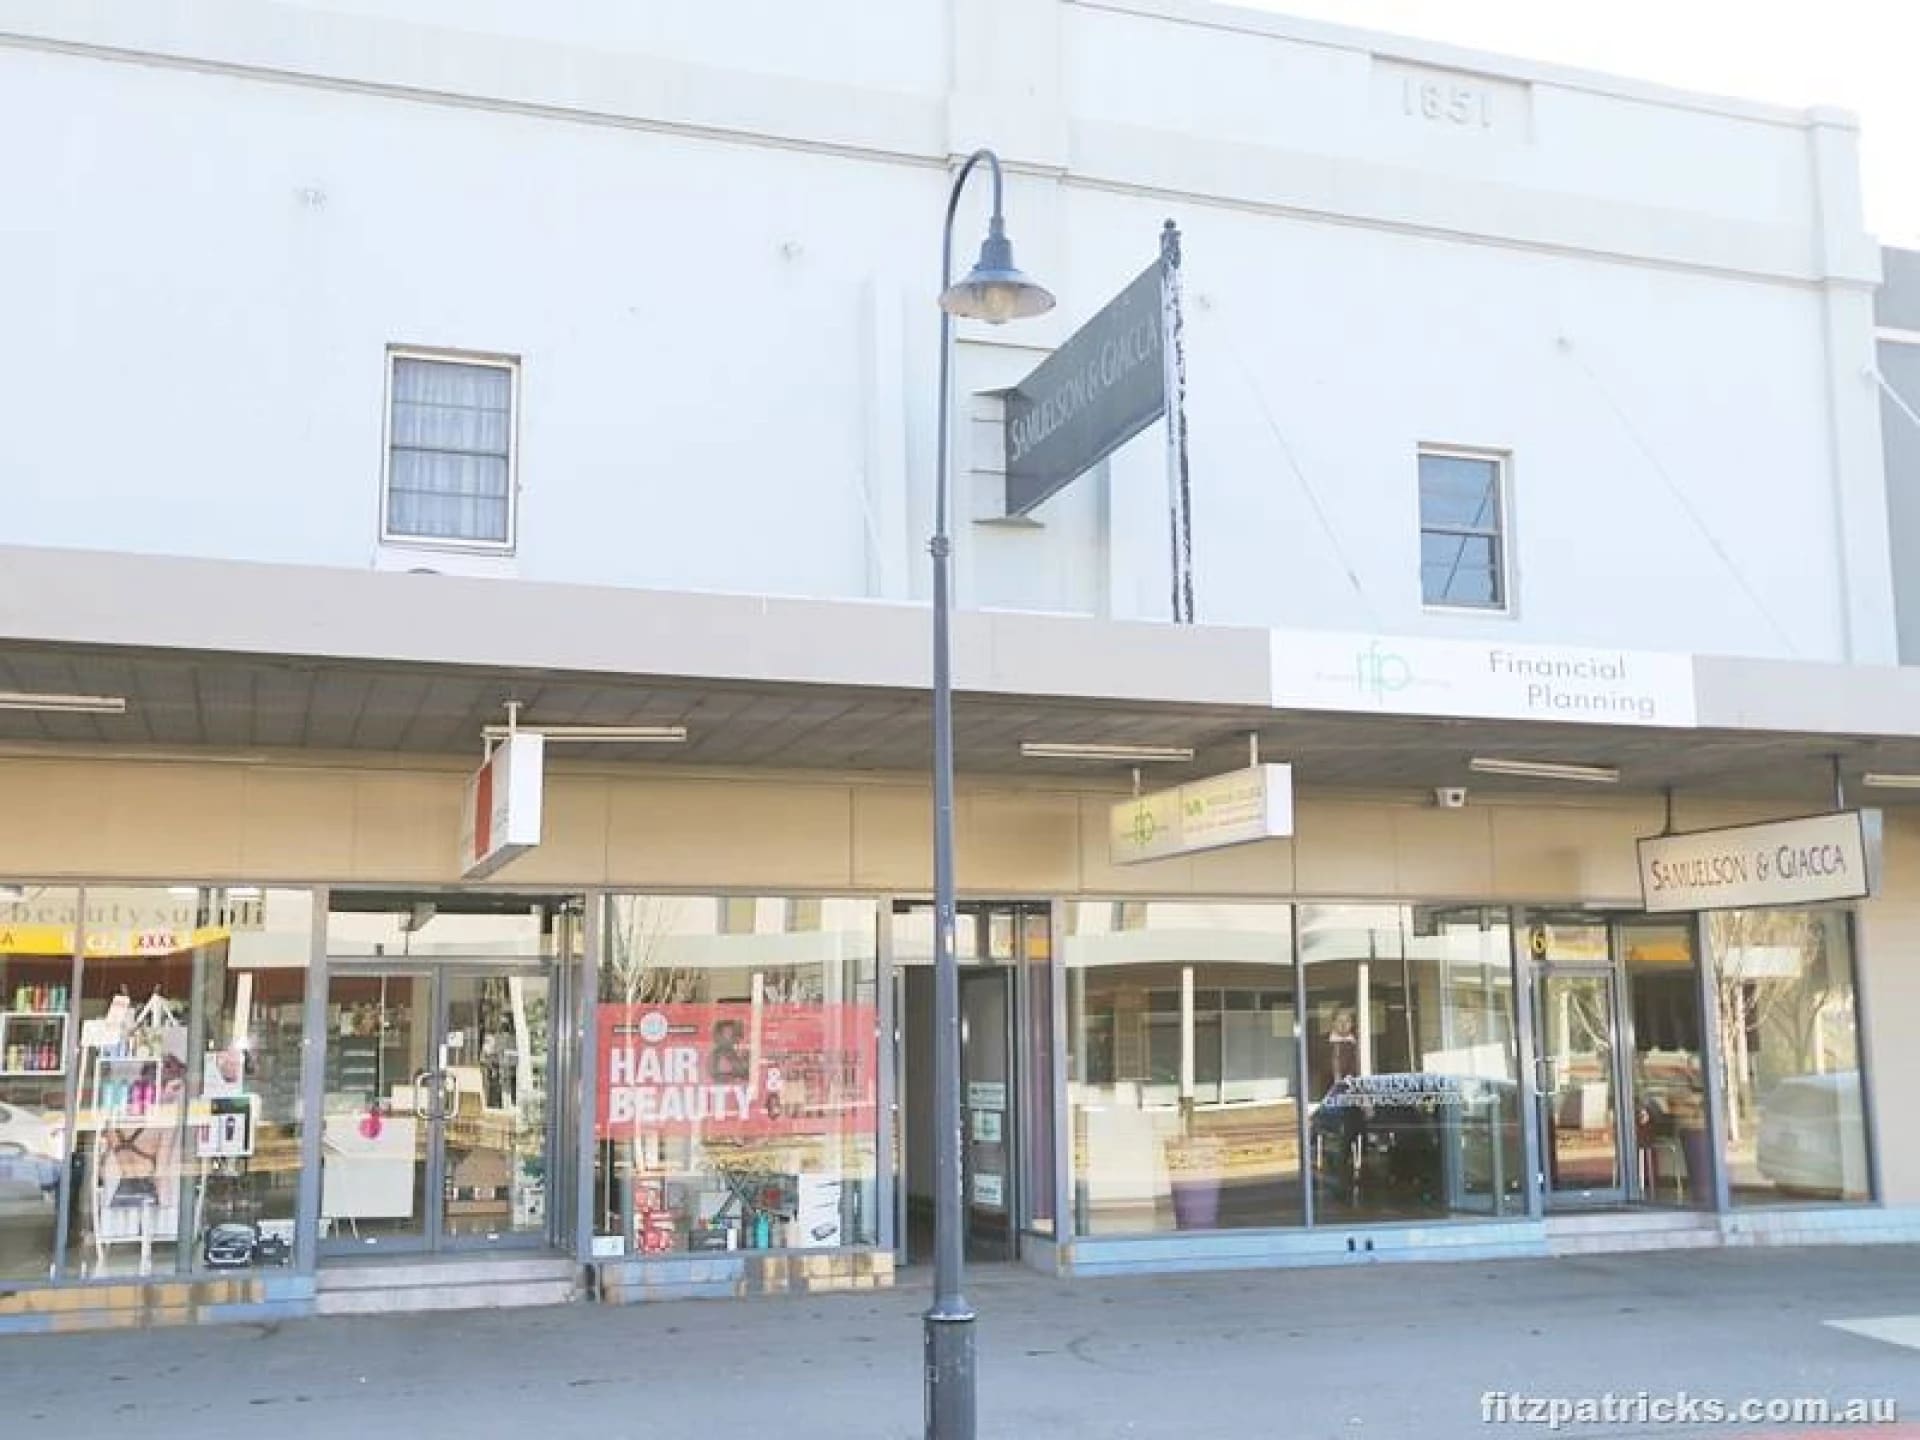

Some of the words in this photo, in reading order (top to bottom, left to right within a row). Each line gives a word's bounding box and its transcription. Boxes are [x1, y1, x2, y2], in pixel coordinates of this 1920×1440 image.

[1010, 364, 1088, 462] SAMUELSON
[1101, 312, 1158, 387] GIACCA
[1489, 649, 1626, 681] Financial
[1527, 683, 1656, 718] Planning
[1651, 852, 1748, 891] SAMUELSON
[1757, 851, 1768, 881] &
[1776, 844, 1847, 879] GIACCA
[610, 1047, 699, 1085] HAIR
[608, 1083, 756, 1125] BEAUTY
